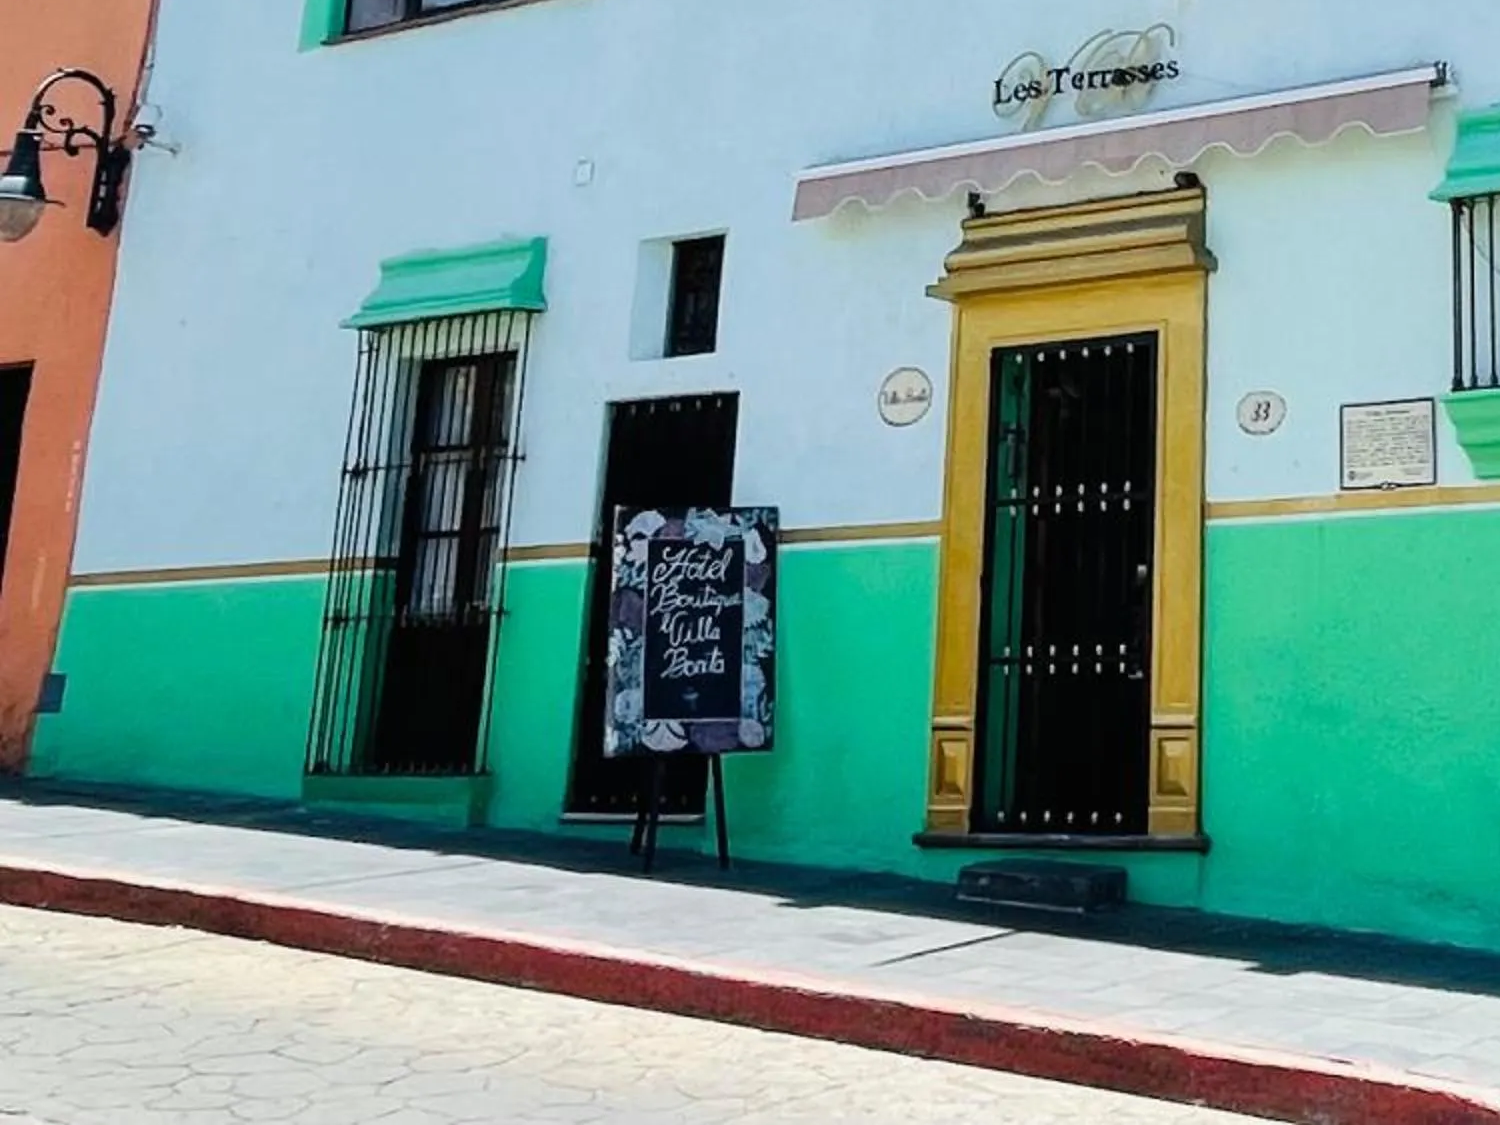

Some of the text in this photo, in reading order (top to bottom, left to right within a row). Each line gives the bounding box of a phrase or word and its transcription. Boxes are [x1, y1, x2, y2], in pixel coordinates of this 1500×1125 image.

[992, 59, 1180, 105] Les Terrasses
[1251, 399, 1271, 423] 33
[653, 547, 733, 583] Hotel
